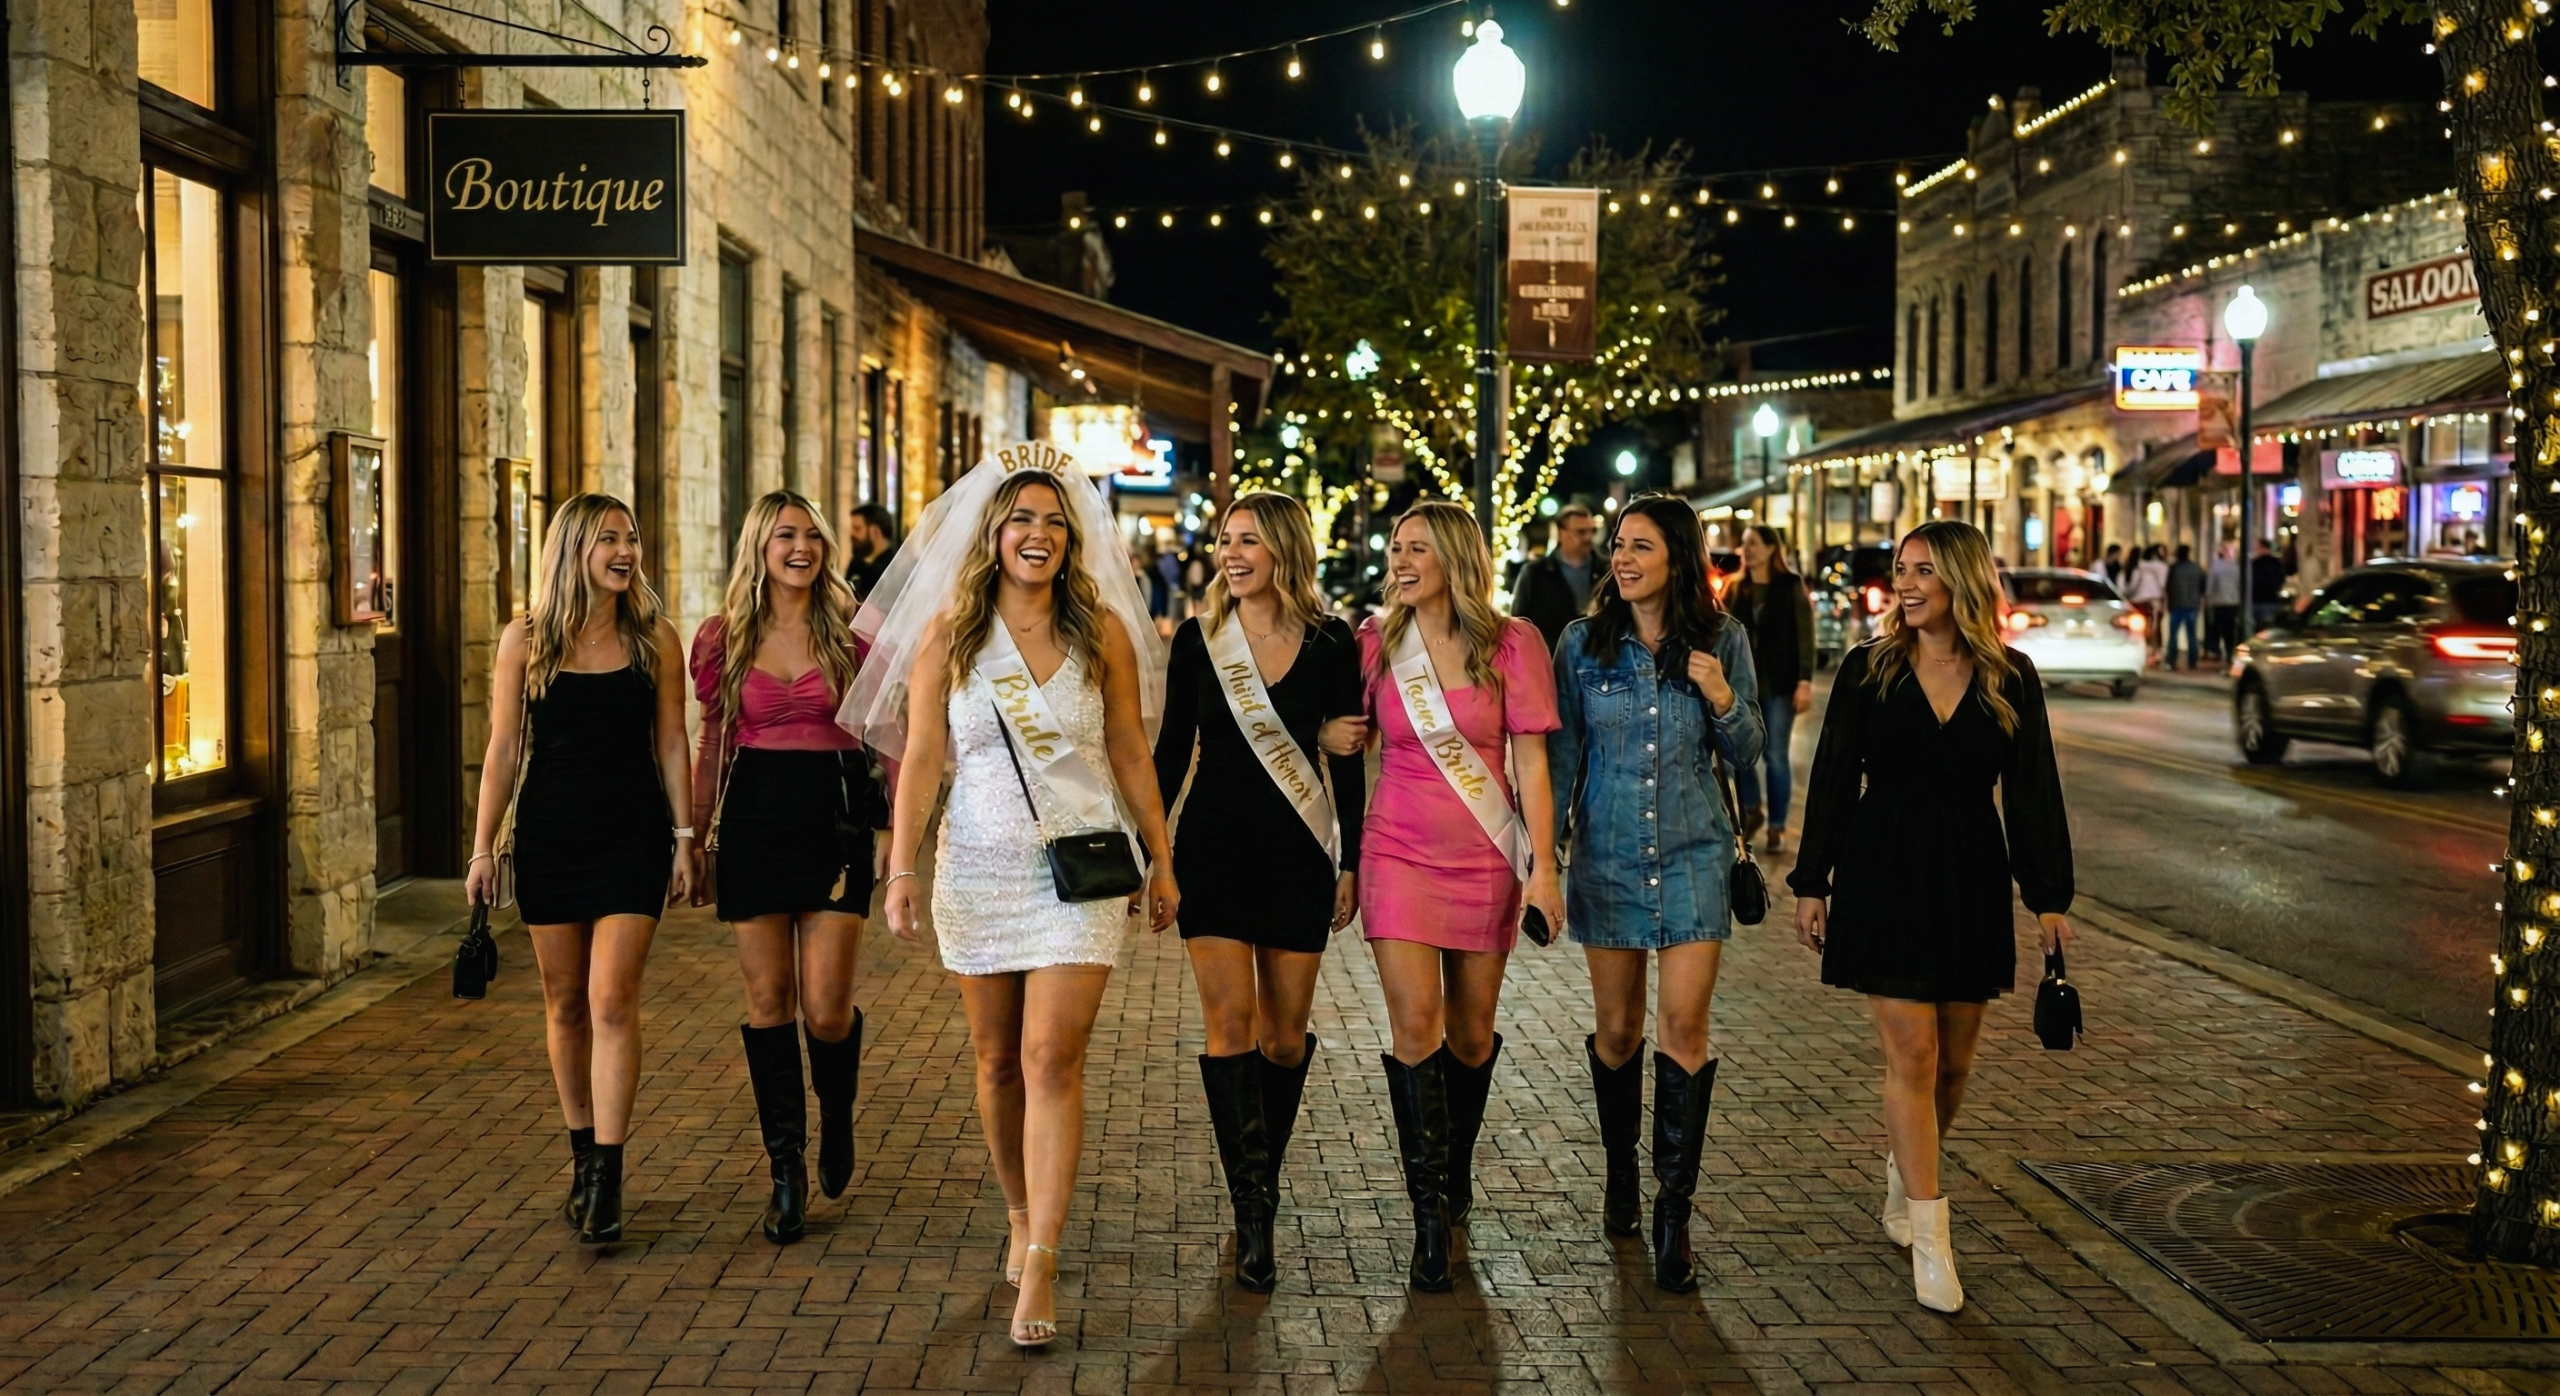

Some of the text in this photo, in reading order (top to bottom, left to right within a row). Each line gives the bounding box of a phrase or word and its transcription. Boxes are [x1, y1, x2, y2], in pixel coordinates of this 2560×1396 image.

[445, 157, 665, 227] Boutique
[2371, 258, 2479, 316] SALOON
[991, 668, 1062, 763] Bride
[1434, 735, 1488, 801] Bride
